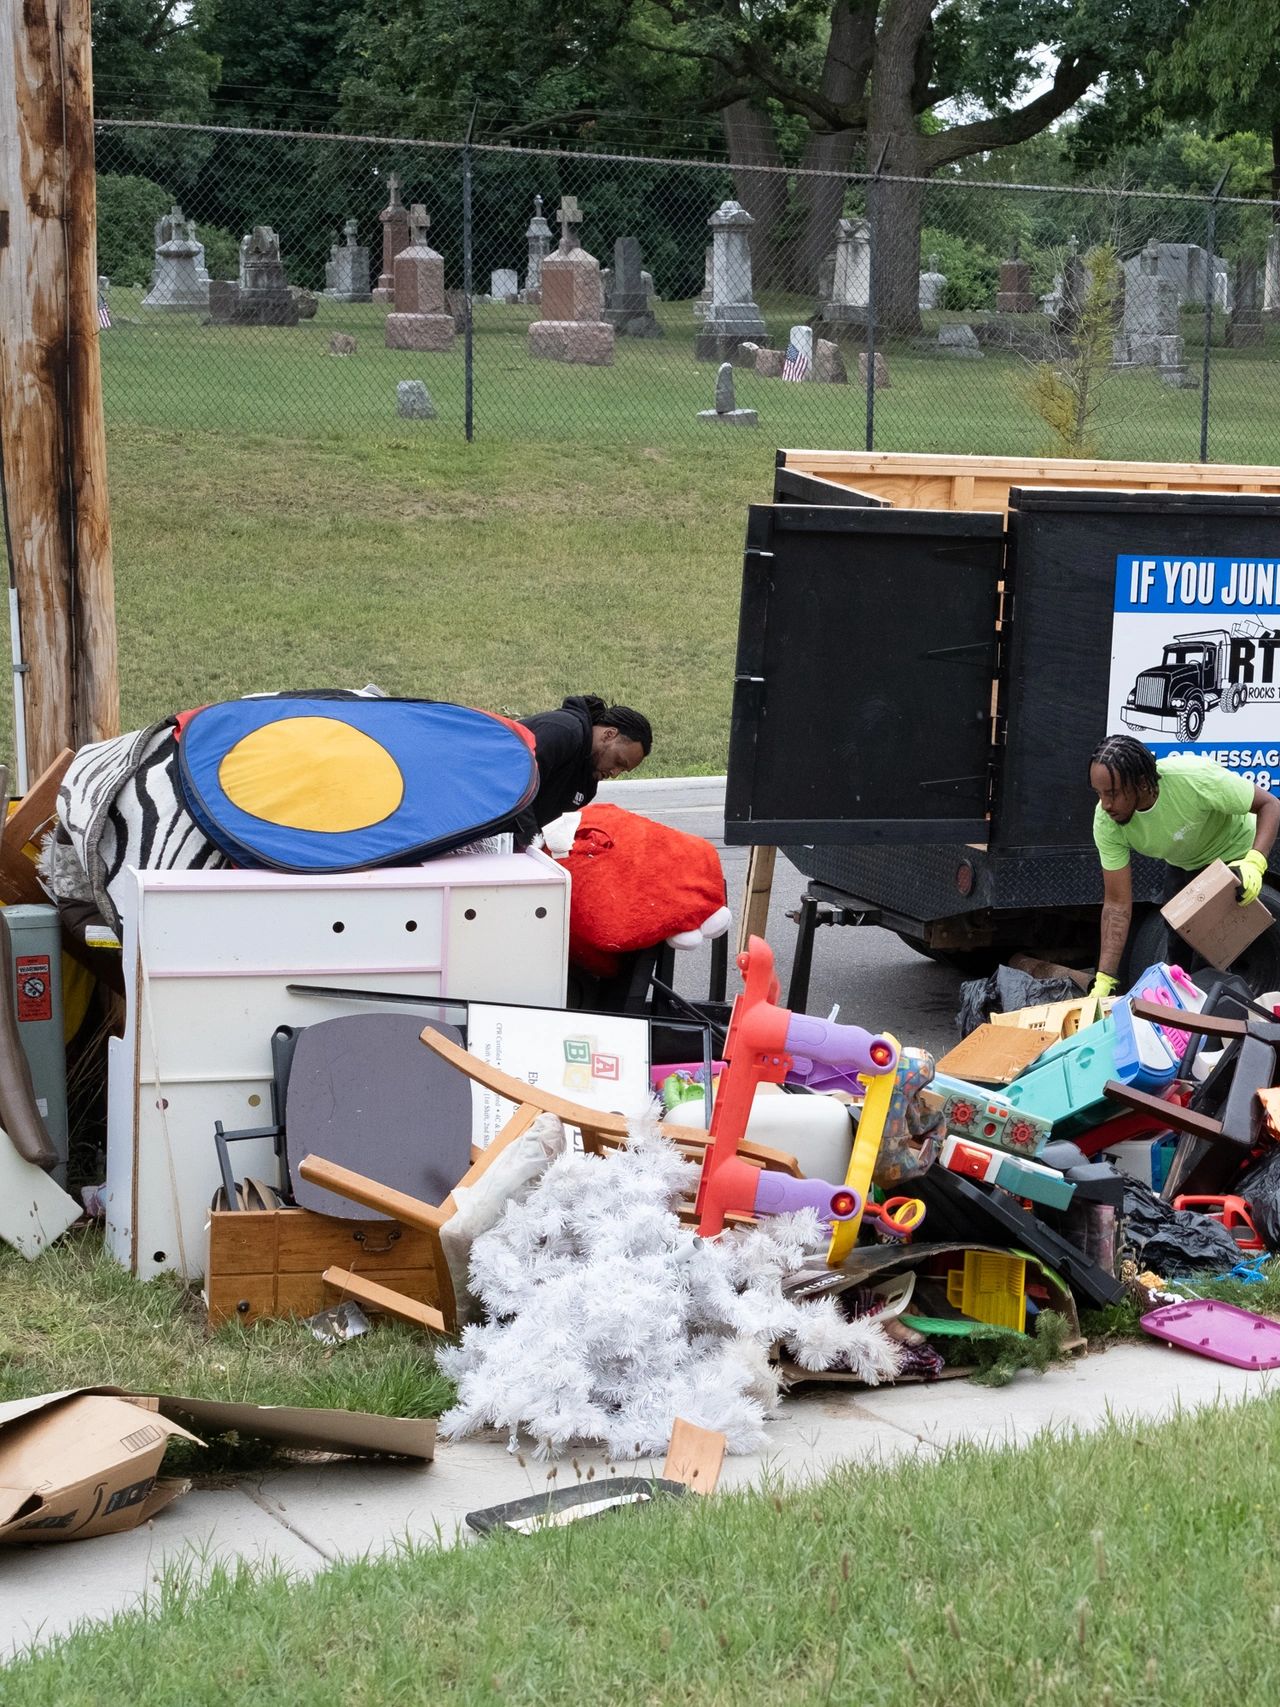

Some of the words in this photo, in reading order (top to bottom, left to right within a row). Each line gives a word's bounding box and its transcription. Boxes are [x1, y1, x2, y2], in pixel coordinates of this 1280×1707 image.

[1130, 561, 1156, 603] IF
[1163, 561, 1215, 605] YOU
[1248, 687, 1275, 698] ROCKS
[19, 965, 48, 973] WARNING
[568, 1043, 587, 1060] B
[596, 1057, 614, 1074] A
